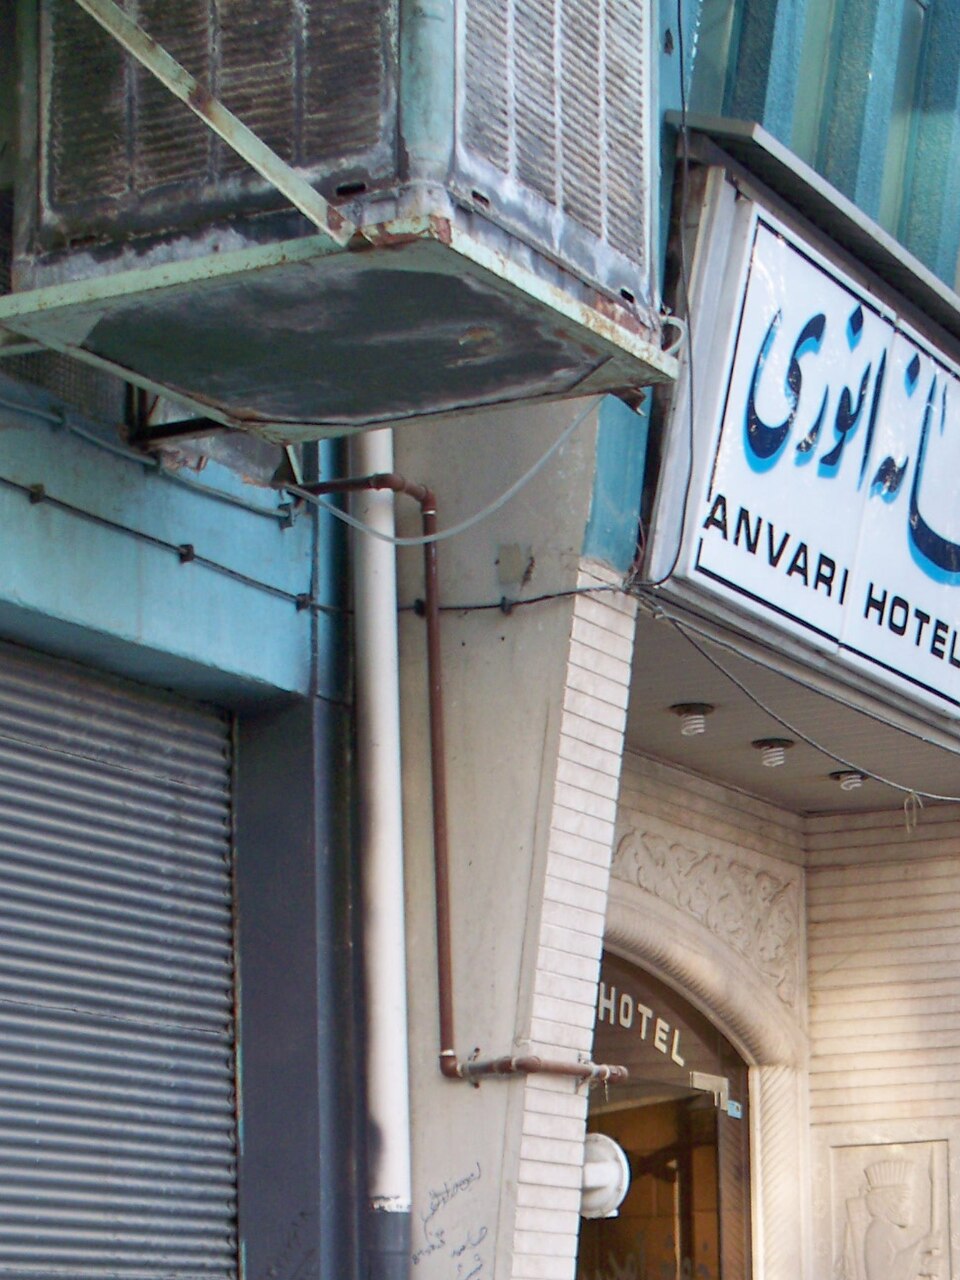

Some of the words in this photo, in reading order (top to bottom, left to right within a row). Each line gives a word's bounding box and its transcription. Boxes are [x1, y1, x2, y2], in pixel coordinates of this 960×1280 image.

[744, 305, 888, 488] انوری
[702, 493, 849, 606] ANVARI
[598, 981, 685, 1068] HOTEL
